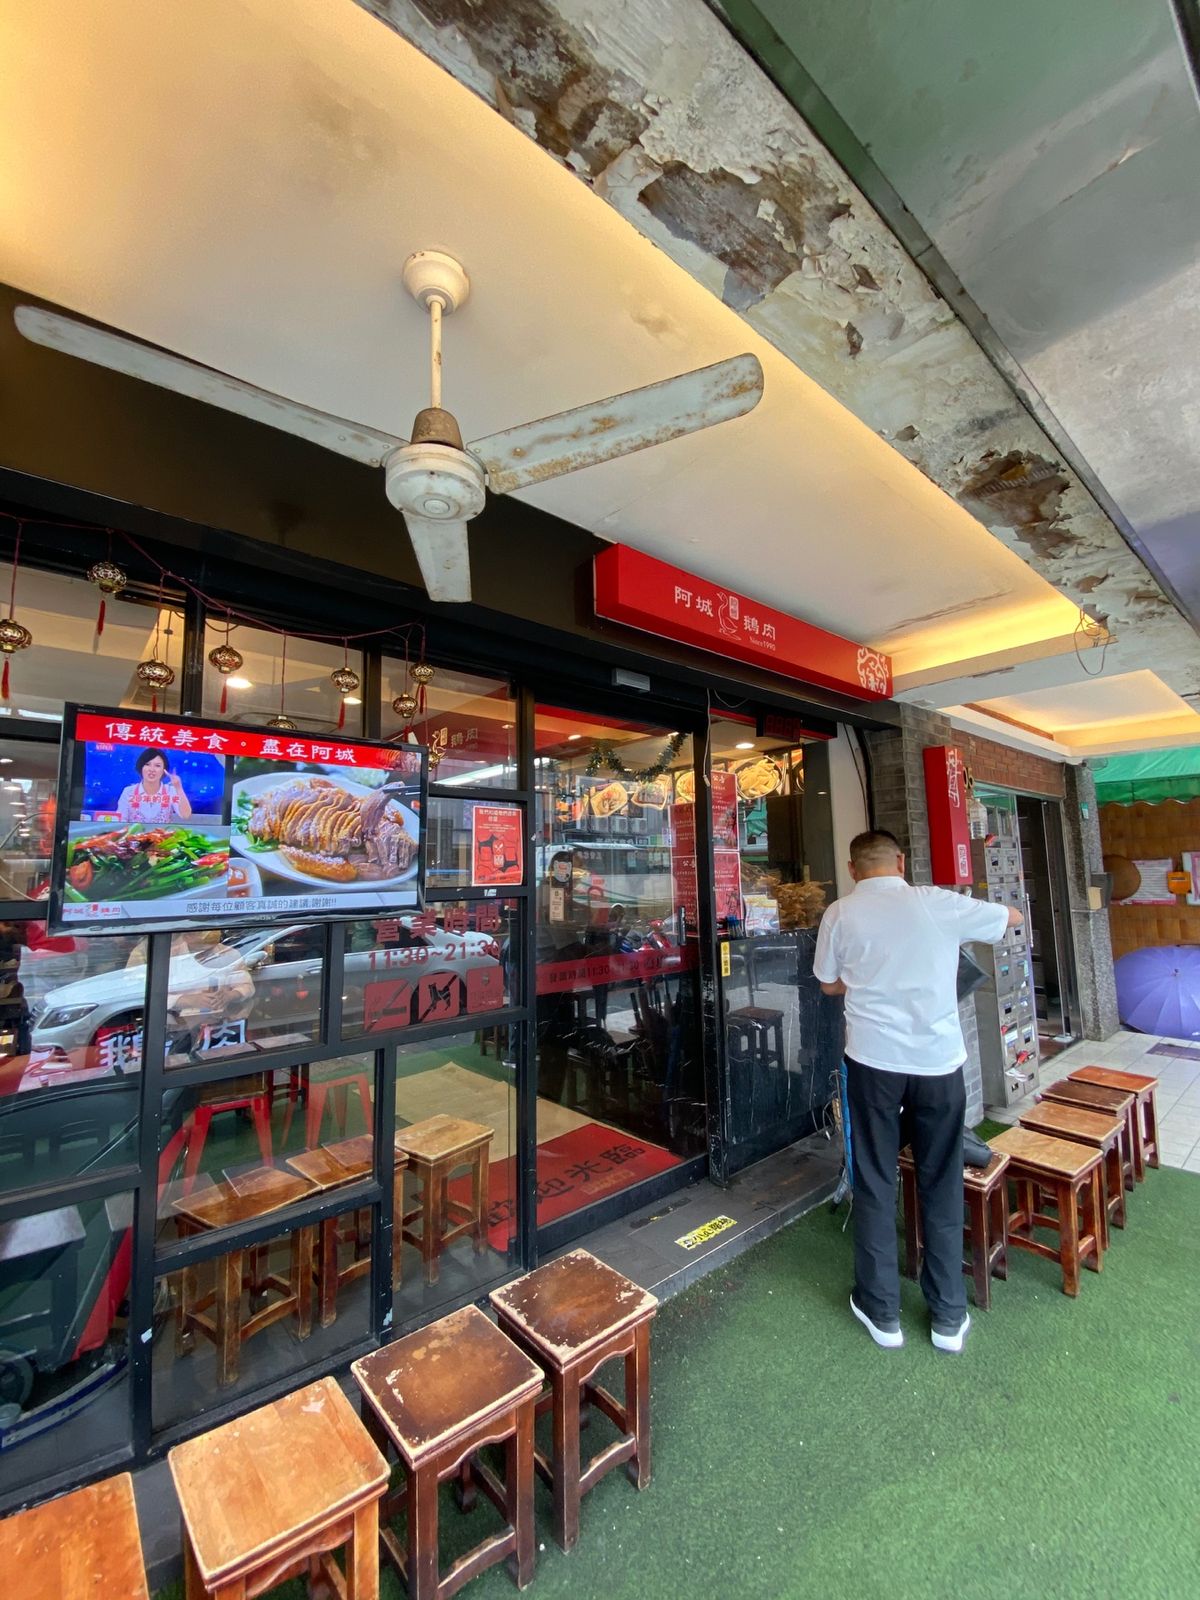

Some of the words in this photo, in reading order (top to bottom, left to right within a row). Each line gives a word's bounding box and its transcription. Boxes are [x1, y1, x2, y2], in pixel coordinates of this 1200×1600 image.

[674, 585, 714, 618] 阿城
[743, 615, 776, 641] 鵝肉
[373, 904, 500, 944] 營業時間
